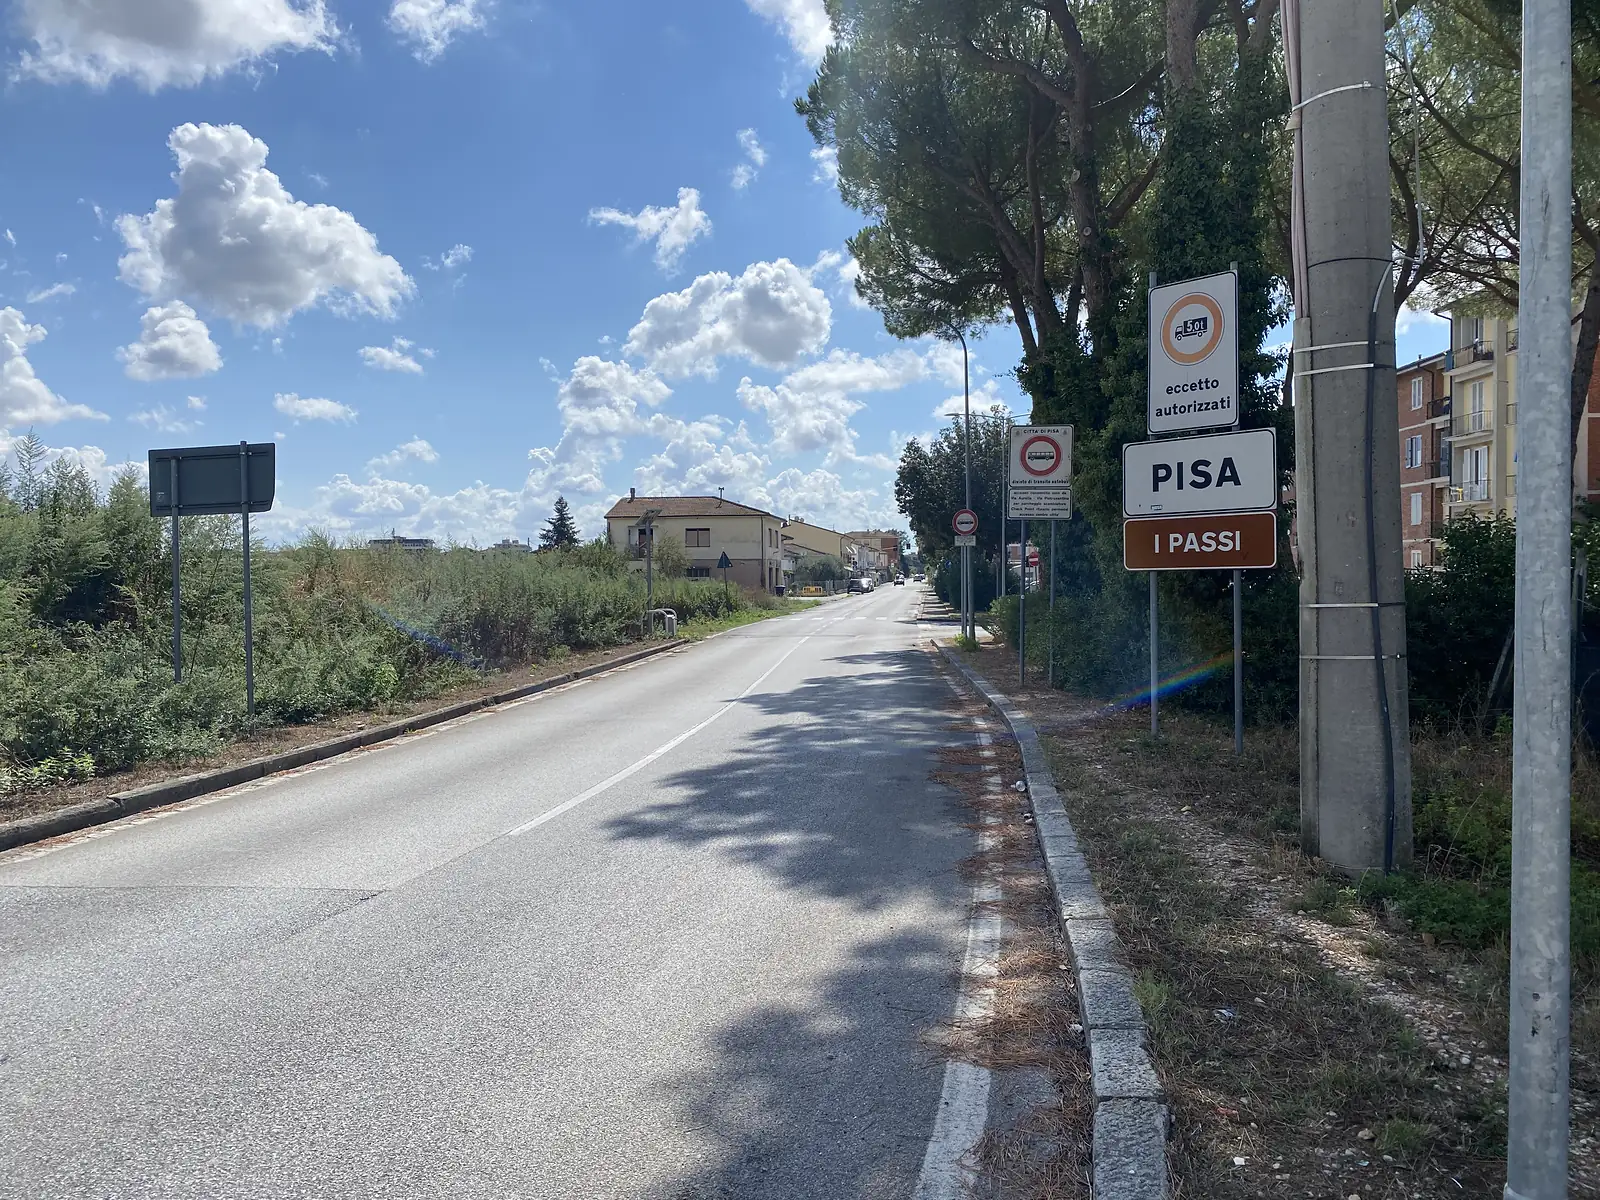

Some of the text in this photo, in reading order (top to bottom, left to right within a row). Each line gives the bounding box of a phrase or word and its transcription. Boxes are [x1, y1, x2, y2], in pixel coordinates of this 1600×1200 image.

[1165, 377, 1220, 395] eccetto
[1155, 396, 1231, 418] autorizzati
[1152, 457, 1241, 493] PISA
[1154, 530, 1241, 554] I PASSI
